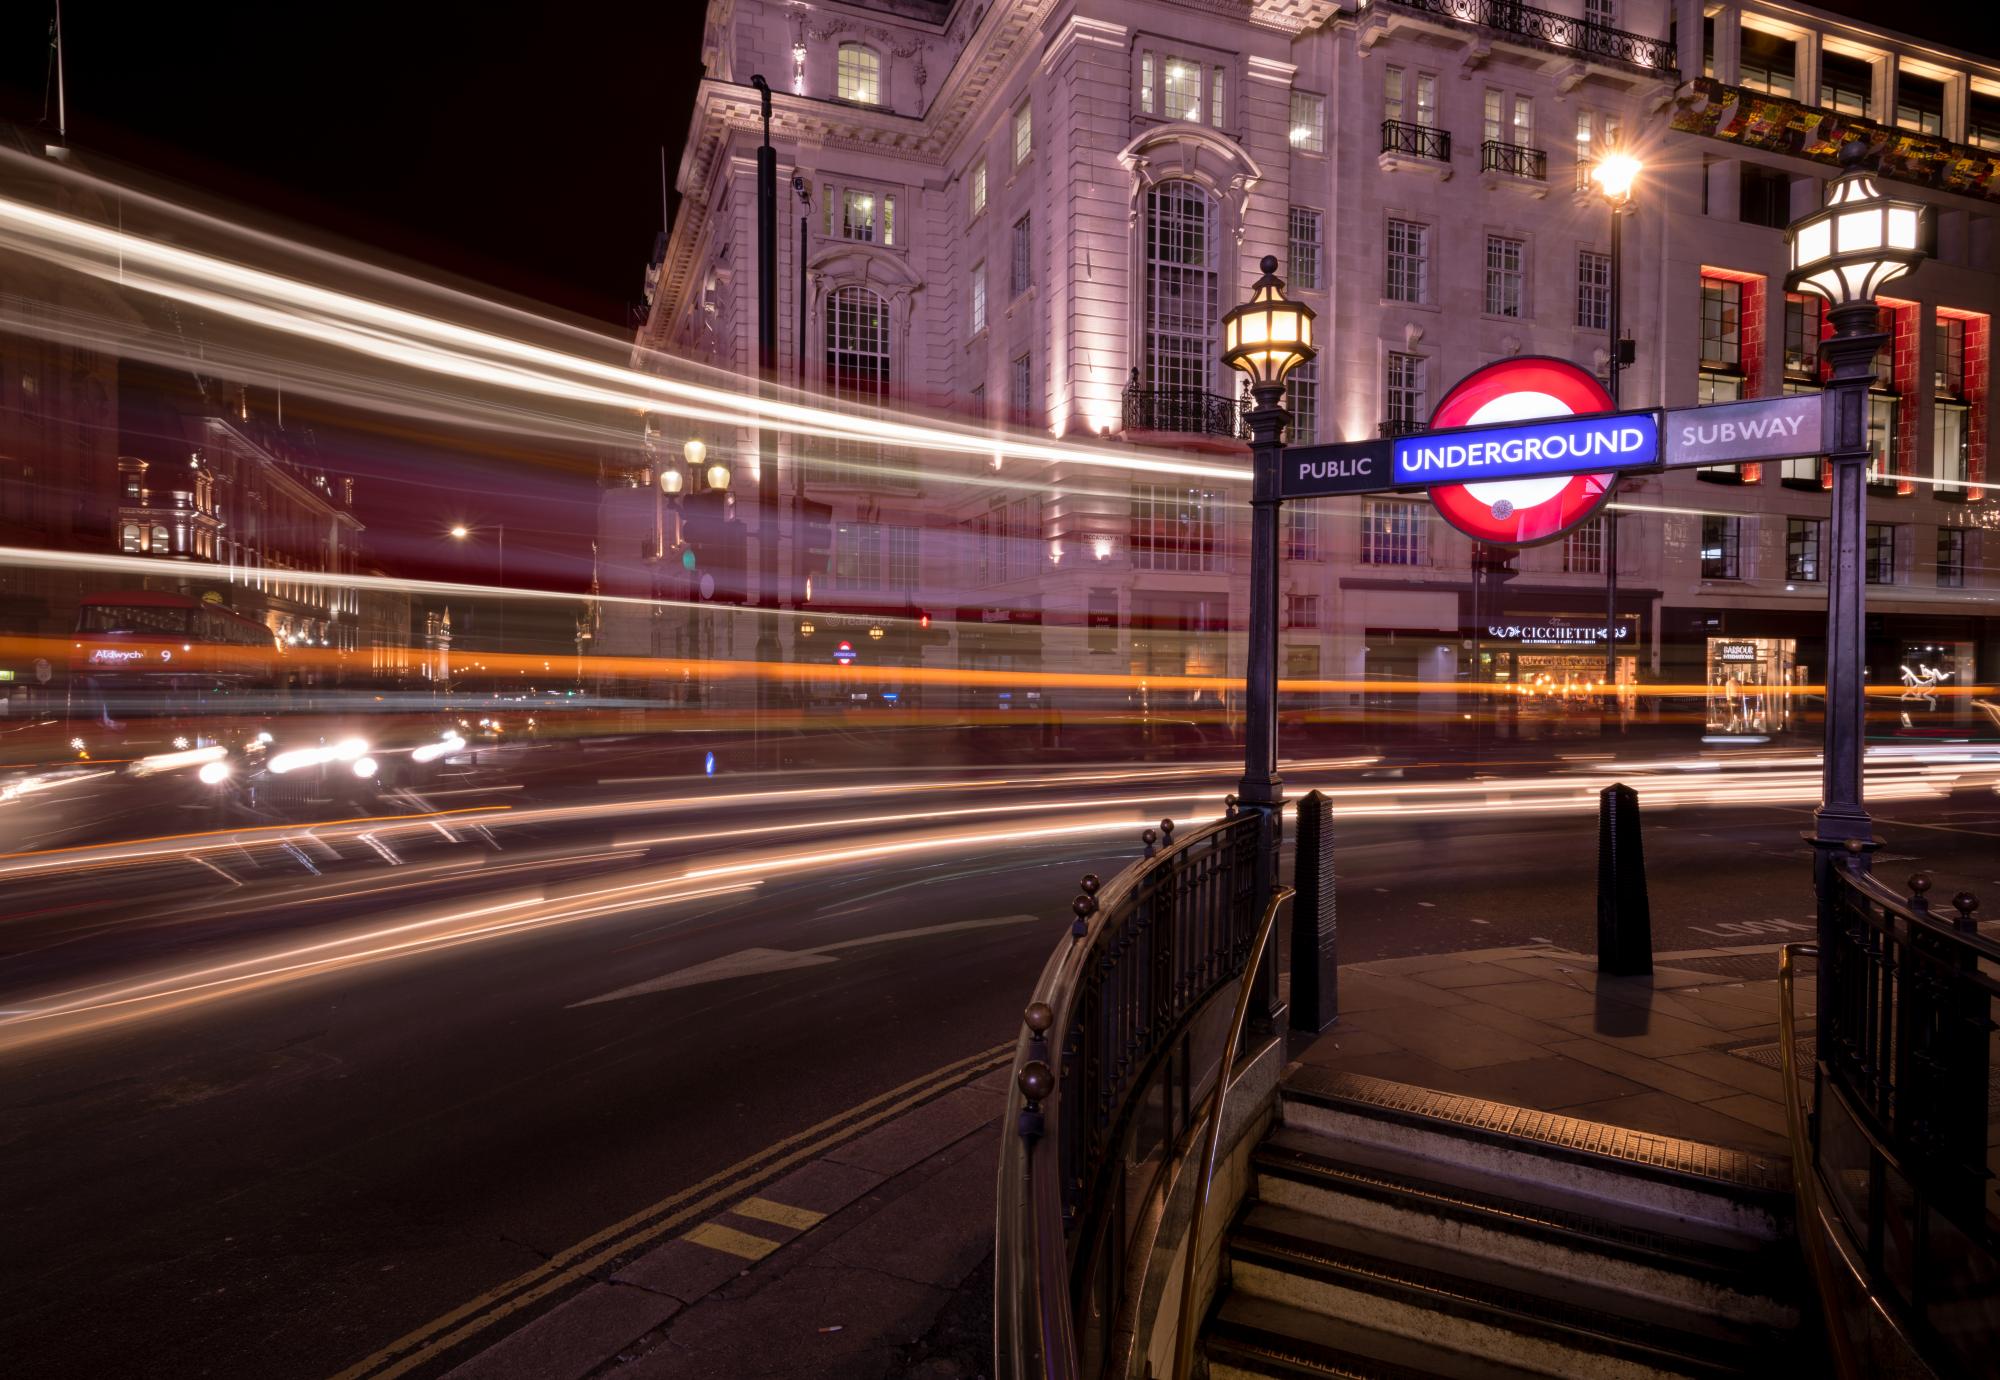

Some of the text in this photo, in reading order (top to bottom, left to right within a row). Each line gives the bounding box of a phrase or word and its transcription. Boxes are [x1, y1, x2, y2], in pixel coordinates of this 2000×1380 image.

[1299, 415, 1806, 481] PUBLIC UNDERGROUND SUBWAY
[1521, 627, 1596, 639] CICCHETTI
[95, 650, 171, 661] Aldwych 9
[1723, 646, 1754, 654] BARBOUR
